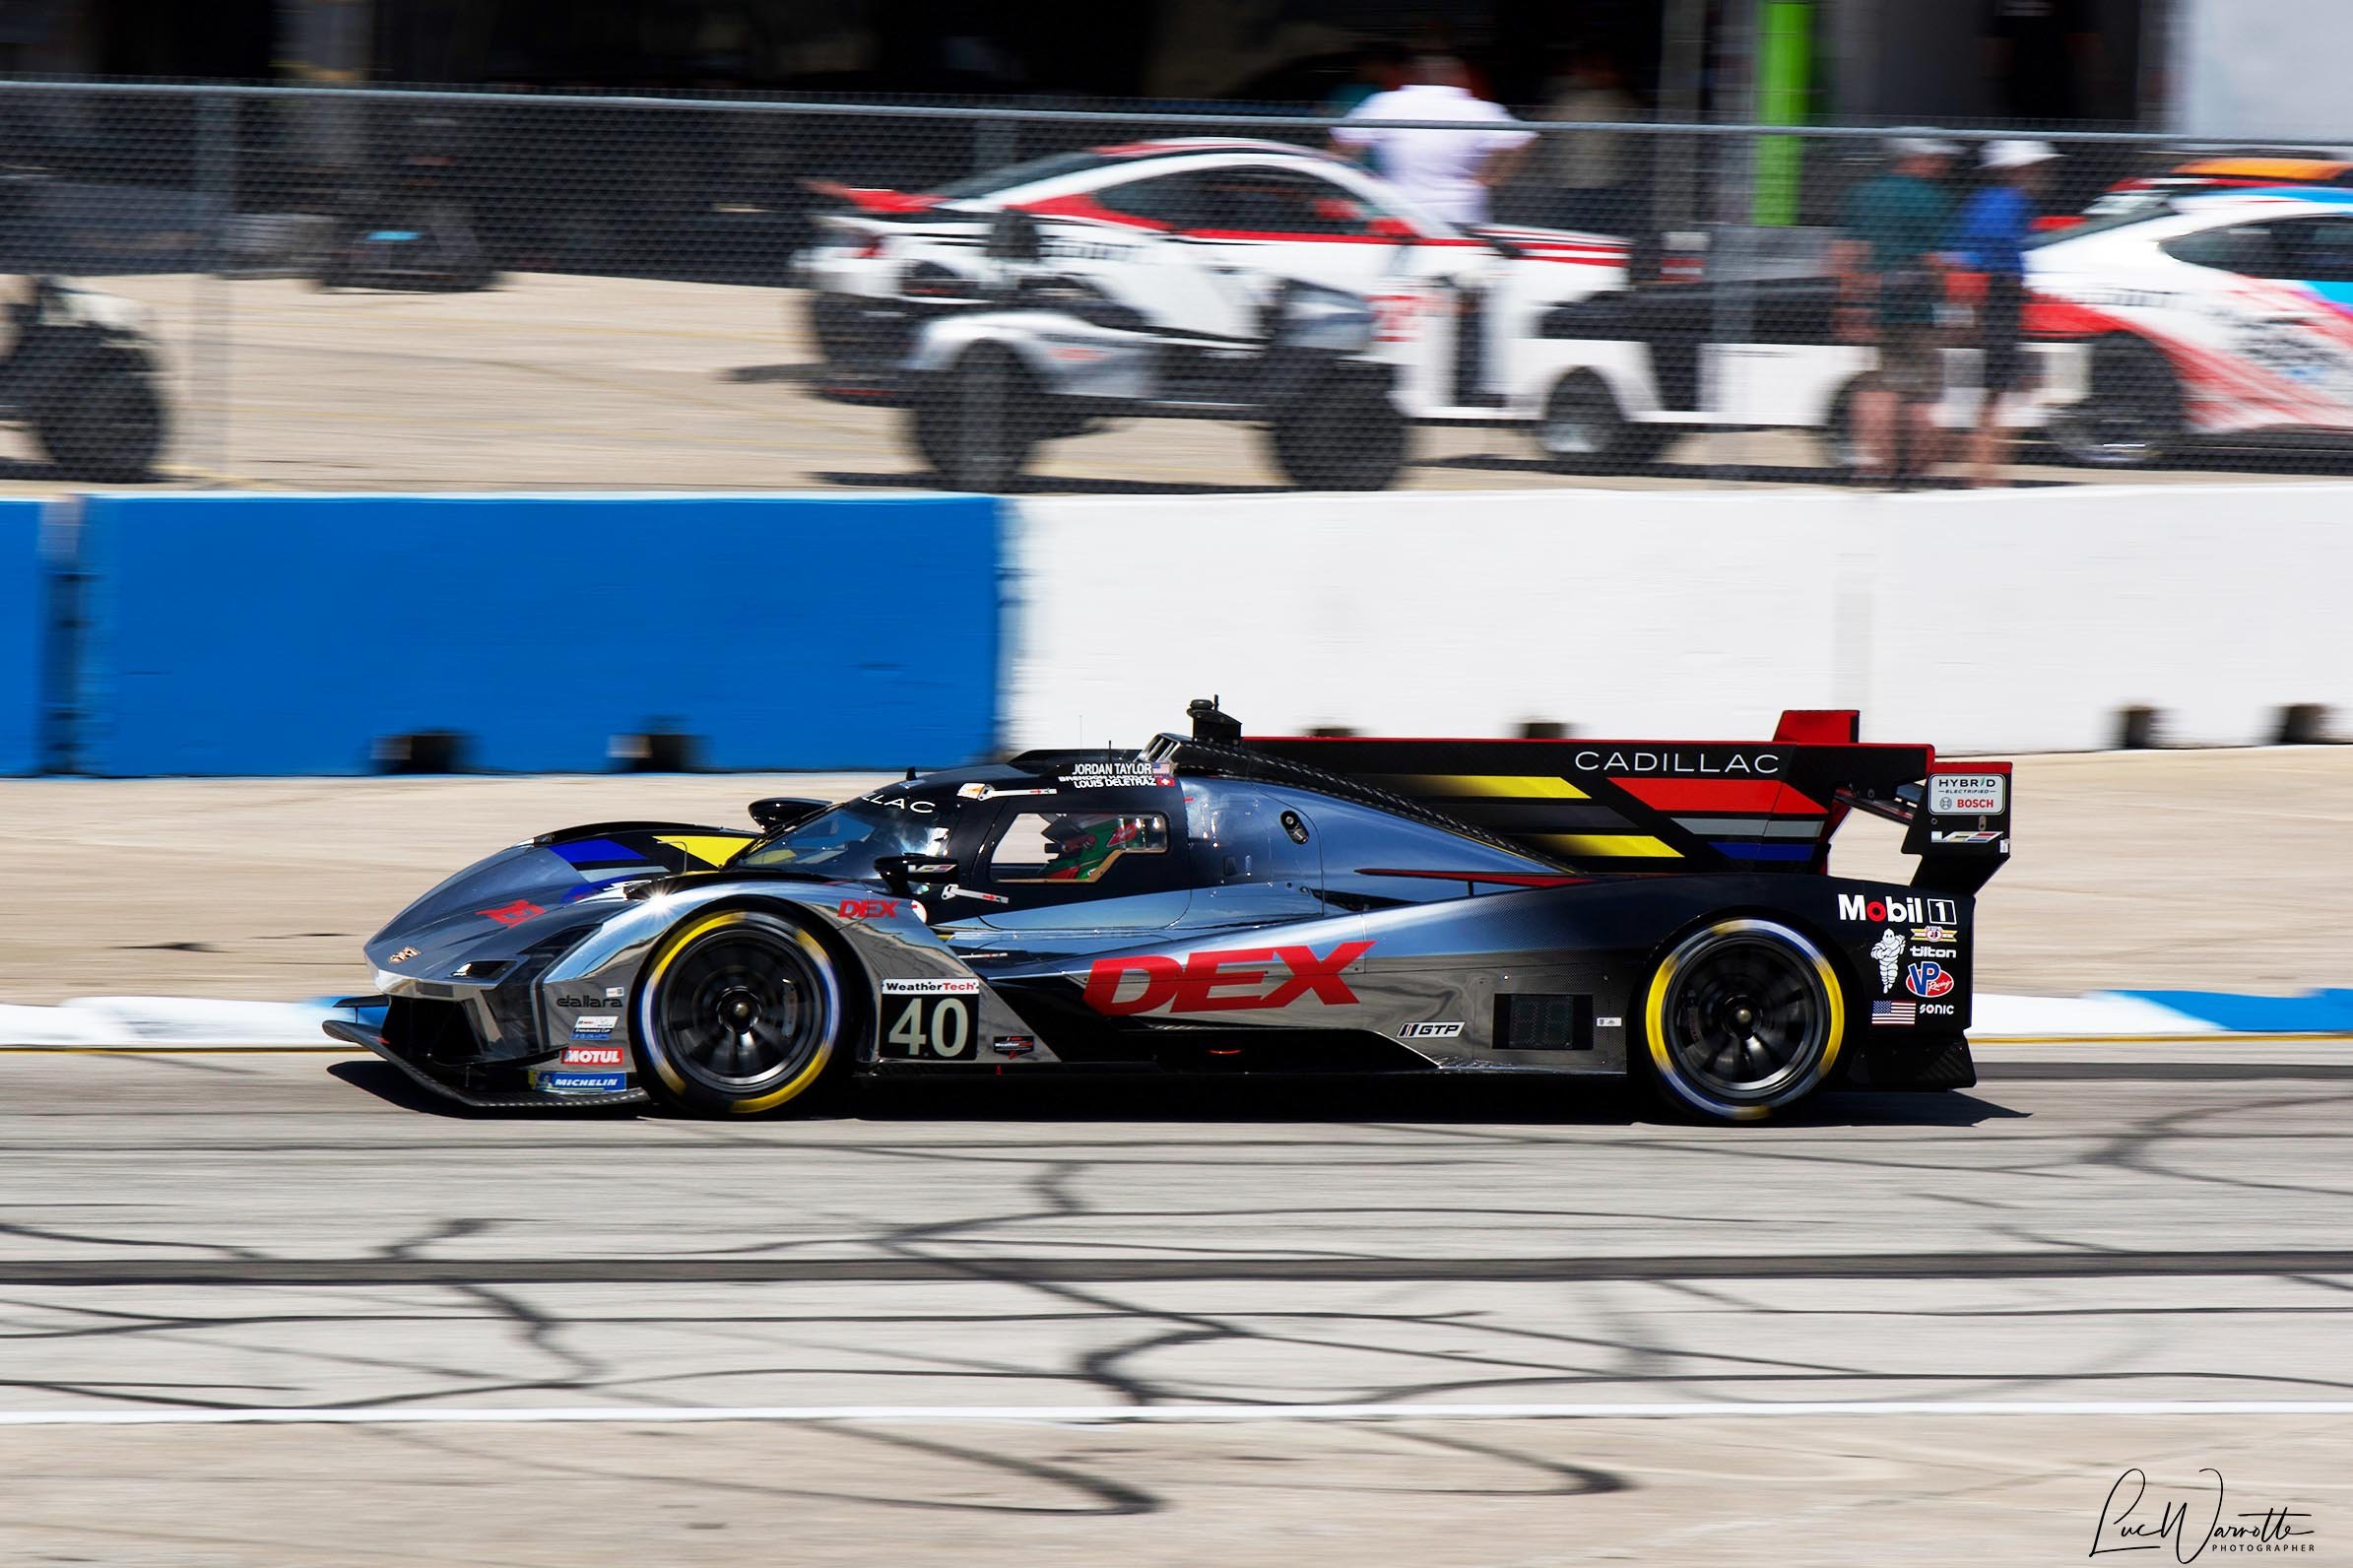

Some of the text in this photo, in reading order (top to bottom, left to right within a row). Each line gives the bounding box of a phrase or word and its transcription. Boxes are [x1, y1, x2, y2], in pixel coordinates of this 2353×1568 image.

[1072, 762, 1152, 775] JORDAN TAYLOR
[1575, 751, 1779, 774] CADILLAC
[1074, 780, 1104, 789] LOUIS
[1105, 777, 1157, 787] DELETRAZ
[1938, 777, 1995, 787] HYBRID
[1957, 799, 1994, 809] BOSCH
[837, 899, 899, 919] DEX
[1838, 893, 1924, 923] Mobil
[1909, 946, 1957, 958] tilton
[1083, 940, 1376, 1016] DEX
[1908, 961, 1941, 997] VP
[885, 982, 975, 991] WeatherTech
[556, 995, 623, 1009] dallara
[888, 997, 969, 1058] 40
[1418, 1025, 1460, 1035] GTP
[564, 1050, 621, 1064] MOTUL
